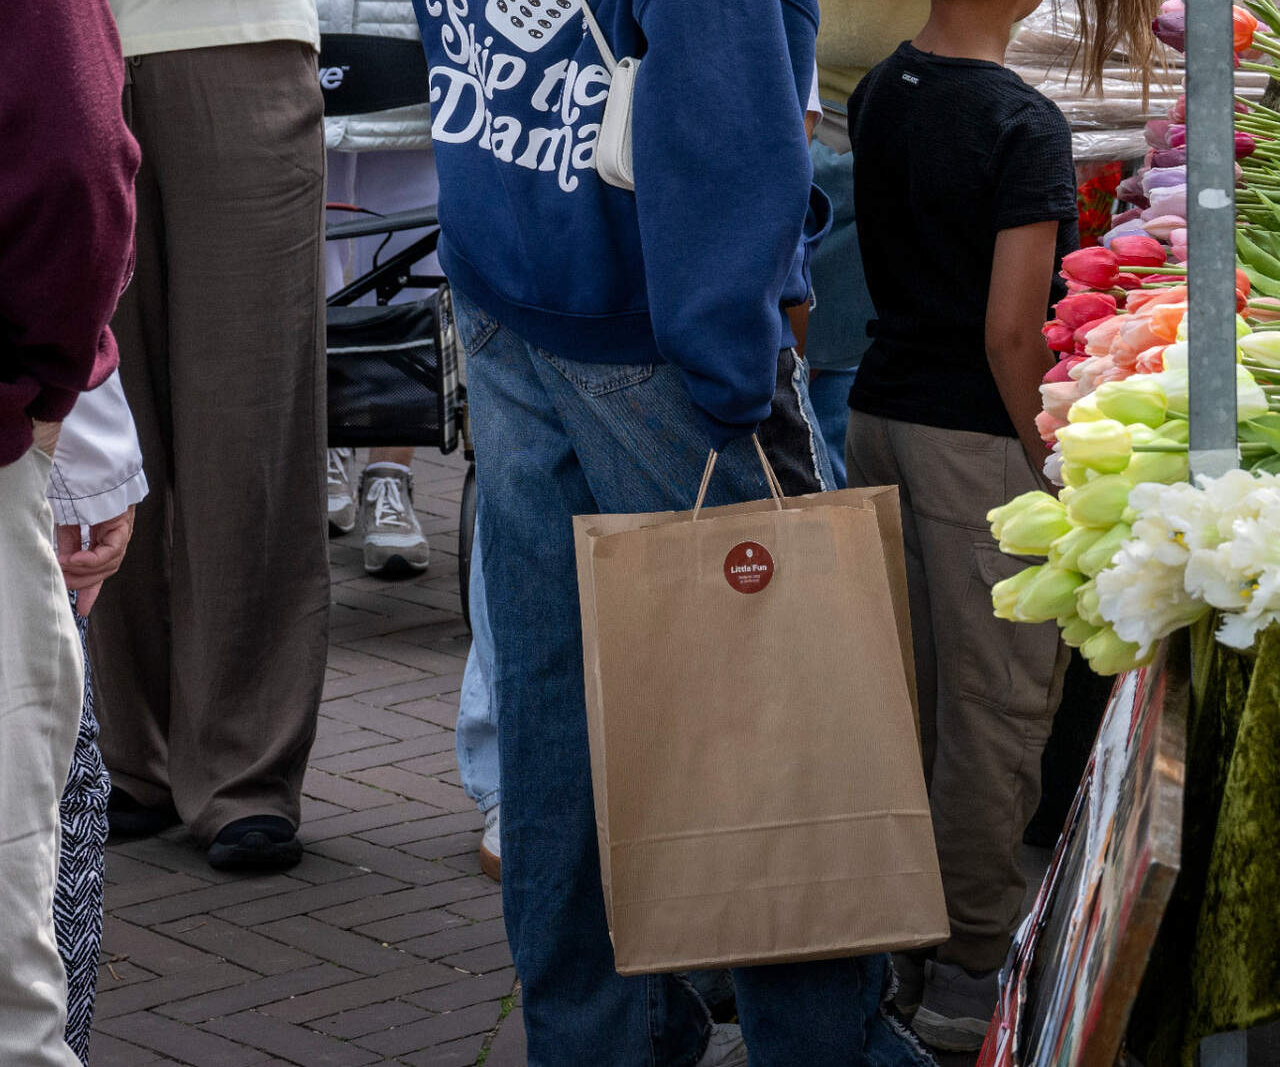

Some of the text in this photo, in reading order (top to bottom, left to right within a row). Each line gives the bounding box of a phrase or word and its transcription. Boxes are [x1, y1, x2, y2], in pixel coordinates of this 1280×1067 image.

[429, 65, 601, 193] Drama
[730, 564, 768, 574] Little Fun
